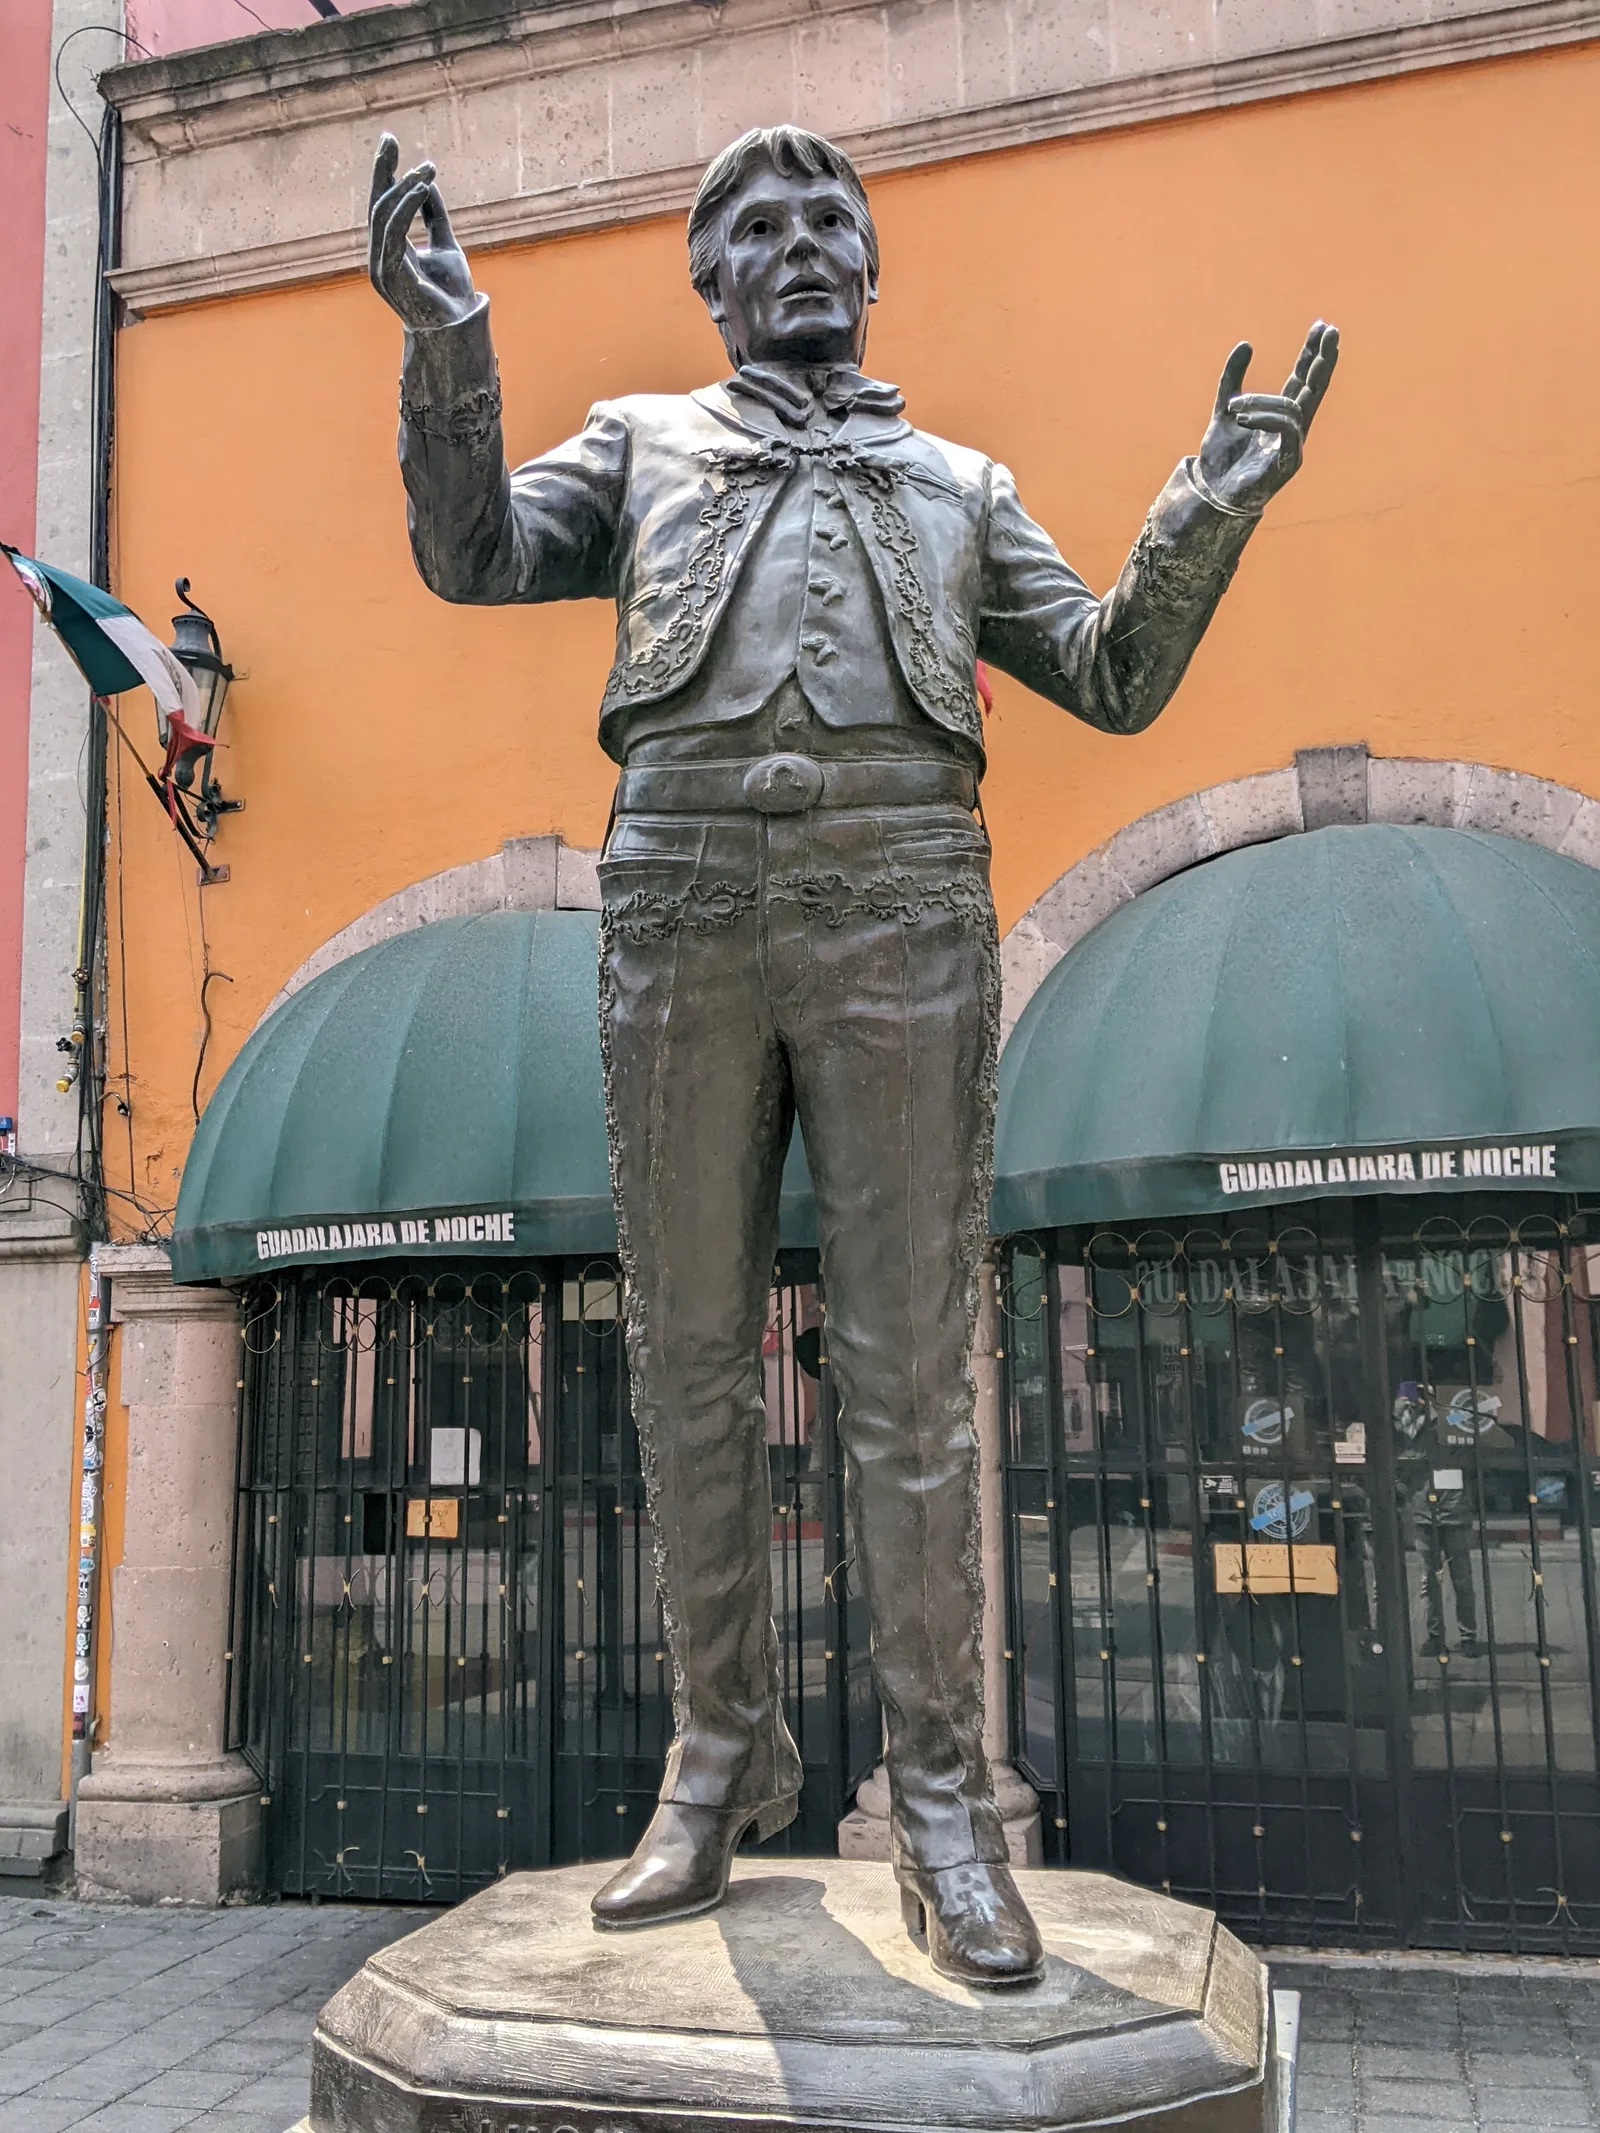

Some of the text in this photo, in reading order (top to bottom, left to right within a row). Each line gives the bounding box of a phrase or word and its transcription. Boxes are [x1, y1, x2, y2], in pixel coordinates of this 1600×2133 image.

[1421, 1150, 1457, 1179] DE
[1463, 1144, 1556, 1177] NOCHE
[257, 1212, 515, 1259] GUADALAJARA DE NOCHE
